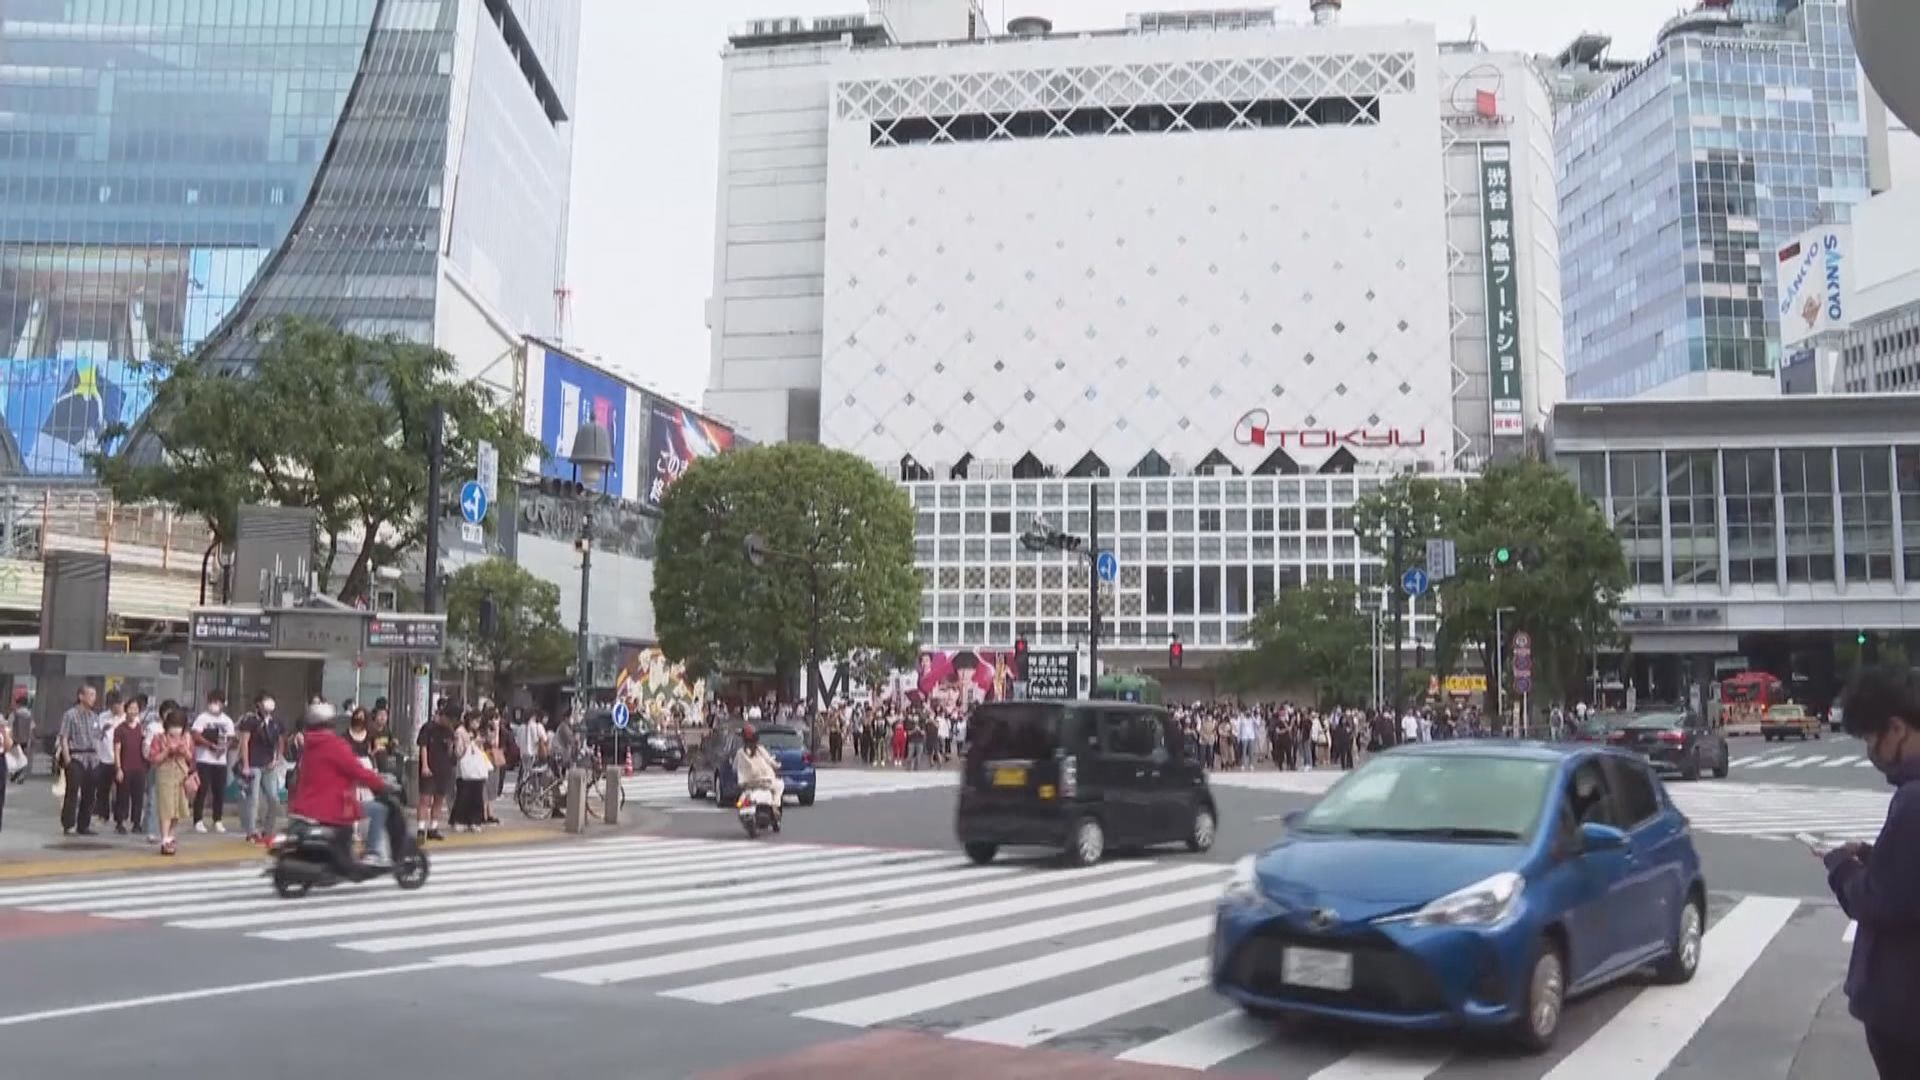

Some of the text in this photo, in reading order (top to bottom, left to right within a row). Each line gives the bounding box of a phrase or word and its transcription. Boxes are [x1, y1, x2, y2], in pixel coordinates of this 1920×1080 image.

[1487, 167, 1507, 211] 渋谷
[1489, 219, 1515, 395] 東急フードショー
[1781, 241, 1819, 315] SANKYO
[1824, 234, 1843, 321] SANKYO
[1267, 428, 1425, 447] TOKYU
